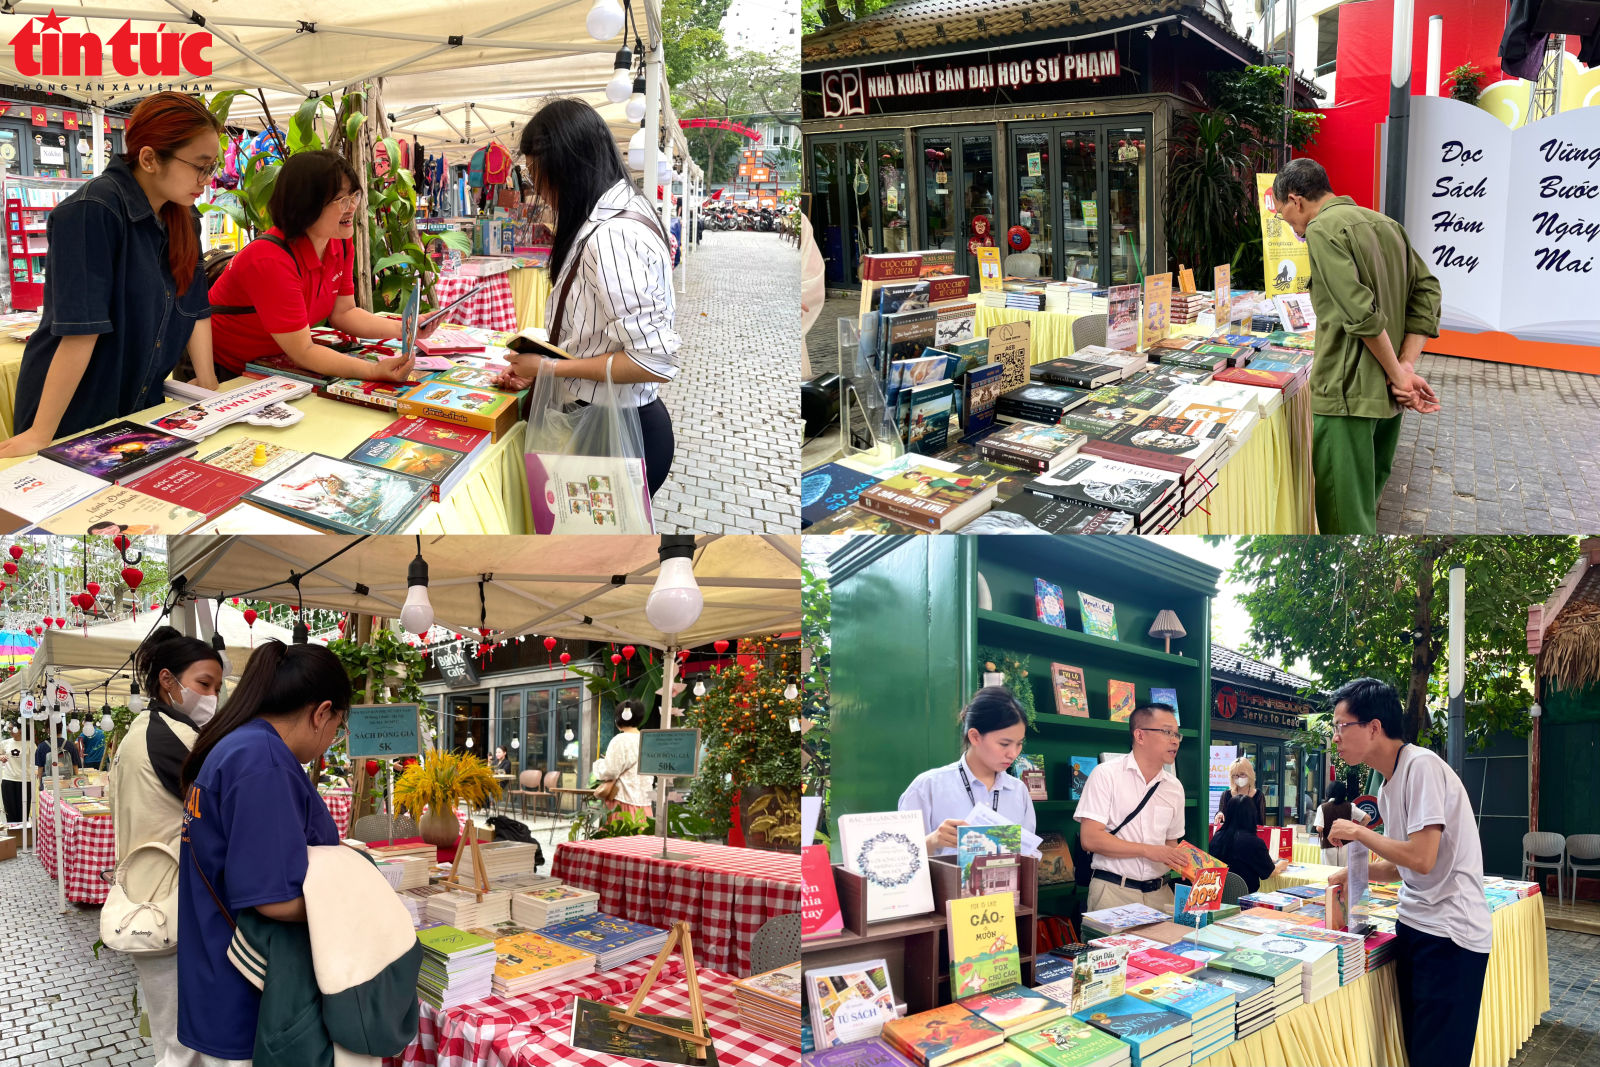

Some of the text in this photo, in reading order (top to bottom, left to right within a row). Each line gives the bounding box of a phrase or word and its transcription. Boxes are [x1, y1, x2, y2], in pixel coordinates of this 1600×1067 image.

[867, 50, 1117, 98] NHÀ XUẤT BẢN ĐẠI HỌC SƯ PHẠM
[1441, 140, 1484, 167] Đọc
[1539, 138, 1600, 169] Vững
[1431, 176, 1488, 198] Sách
[1539, 175, 1600, 199] Bước
[1431, 210, 1485, 233] Hôm
[1532, 211, 1600, 243] Ngày
[1432, 245, 1479, 274] Nay
[1534, 247, 1594, 273] Mai
[215, 399, 249, 412] NAM
[23, 481, 45, 493] AQ
[846, 478, 876, 494] MÁY
[437, 652, 465, 666] BOOK
[447, 665, 466, 677] cafe
[1270, 713, 1279, 722] to
[1282, 715, 1300, 728] Lead
[355, 729, 415, 740] SÁCH ĐỒNG GIÁ
[379, 742, 393, 751] 5K
[678, 751, 690, 759] GIÁ
[658, 762, 676, 771] 50K
[1188, 887, 1218, 907] 30%
[802, 908, 824, 919] tay
[994, 963, 1008, 972] FOX
[851, 1008, 877, 1022] SÁCH
